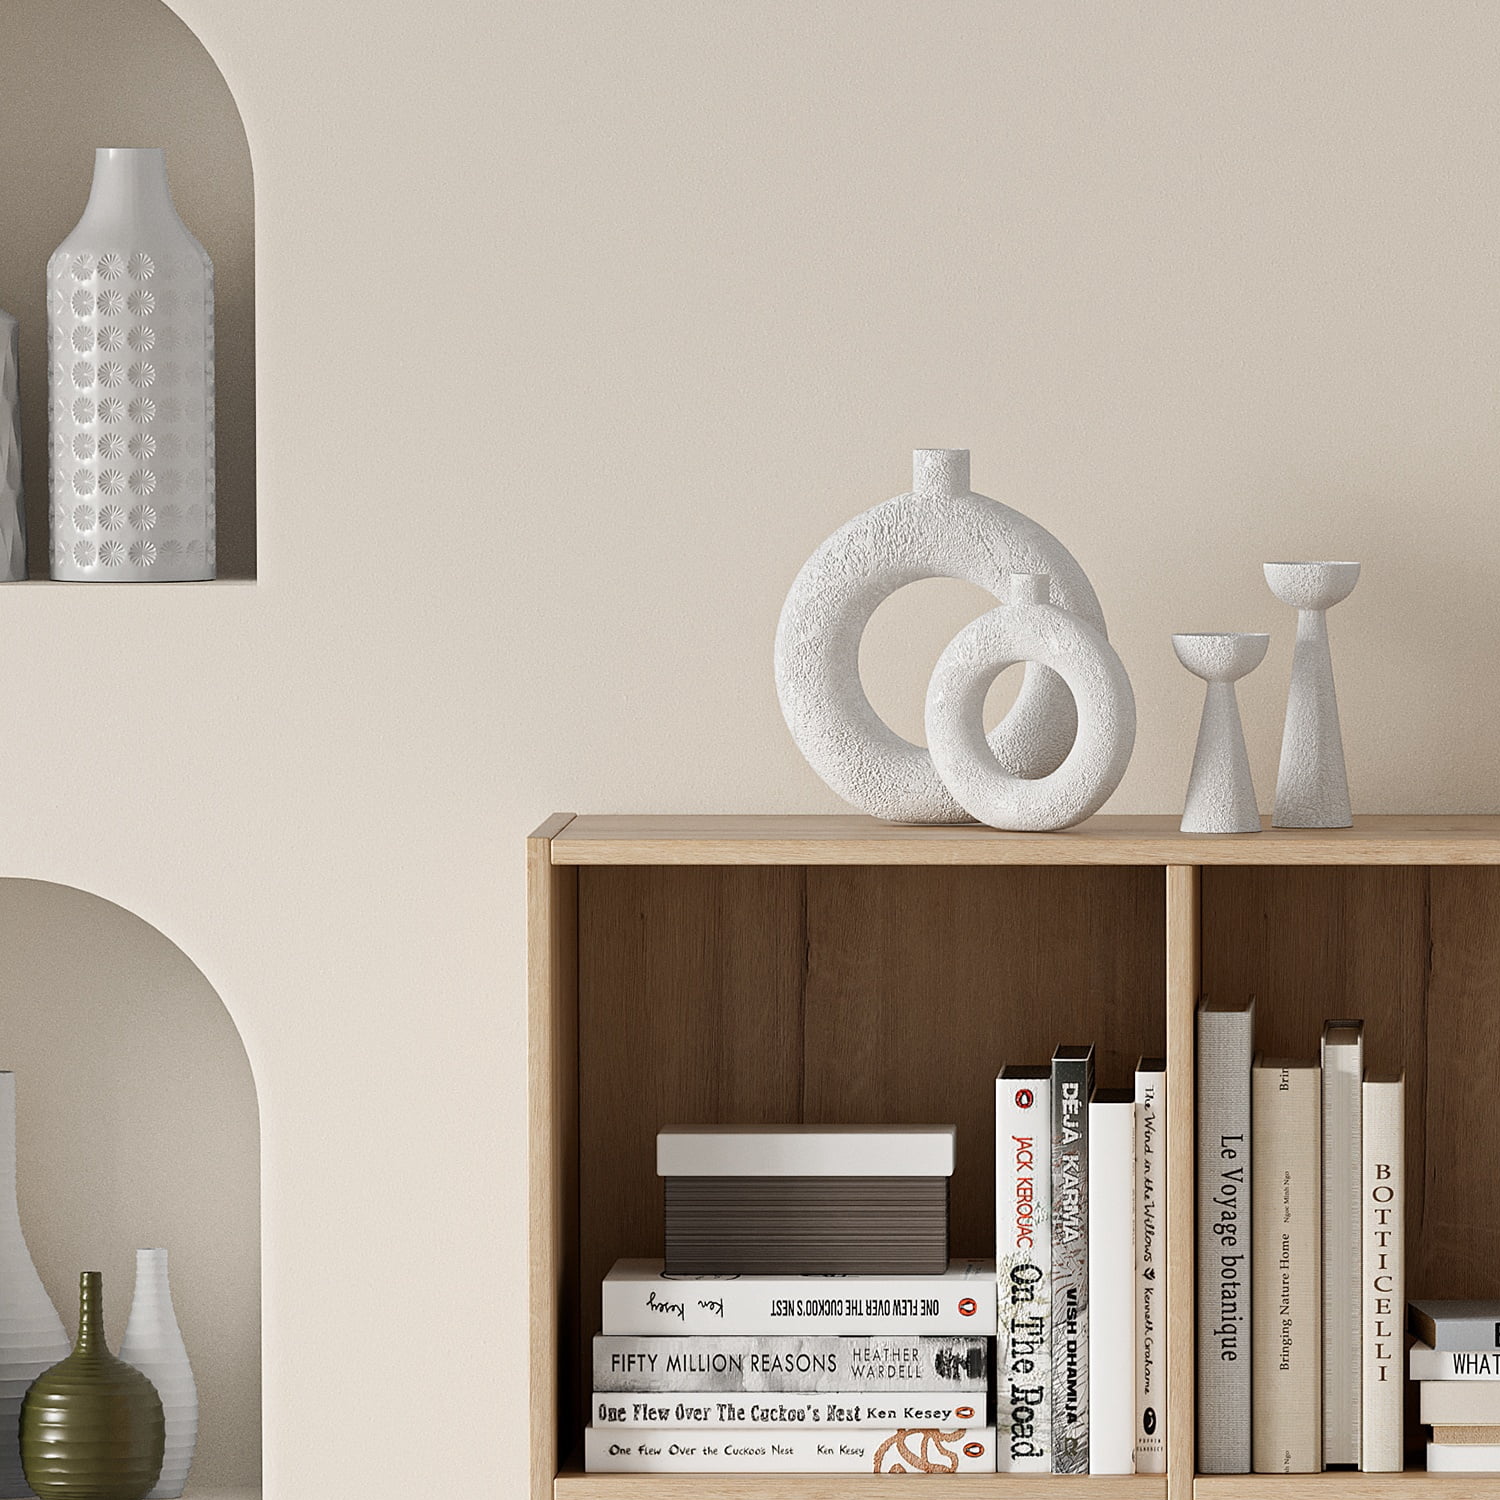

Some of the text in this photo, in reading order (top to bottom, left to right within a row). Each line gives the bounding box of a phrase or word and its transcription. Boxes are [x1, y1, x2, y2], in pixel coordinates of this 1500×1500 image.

[1143, 1086, 1156, 1262] The Wind in the Willows
[1012, 1136, 1036, 1248] JACK KEROUAC
[1061, 1153, 1081, 1244] KARMA
[1210, 1134, 1245, 1361] Le Voyage botanique
[1373, 1164, 1394, 1381] BOTTICELLI
[646, 1292, 723, 1321] Ken Kesey
[771, 1300, 794, 1316] NEST
[845, 1300, 863, 1316] THE
[866, 1300, 890, 1316] OVER
[893, 1300, 917, 1316] FLEW
[921, 1300, 939, 1316] ONE
[1279, 1233, 1293, 1371] Bringing Nature Home
[1143, 1287, 1154, 1395] Kenneth Grahame
[612, 1353, 838, 1373] FIFTY MILLION REASONS
[852, 1347, 919, 1363] HEATHER
[1003, 1263, 1045, 1461] On The Road
[1063, 1286, 1080, 1424] VISH DHAMIJA
[851, 1364, 921, 1379] WARDELL
[598, 1403, 626, 1422] One
[633, 1404, 670, 1421] Flew
[675, 1404, 711, 1421] Over
[716, 1404, 745, 1421] The
[827, 1405, 861, 1421] Nest
[866, 1407, 952, 1421] Ken Kesey
